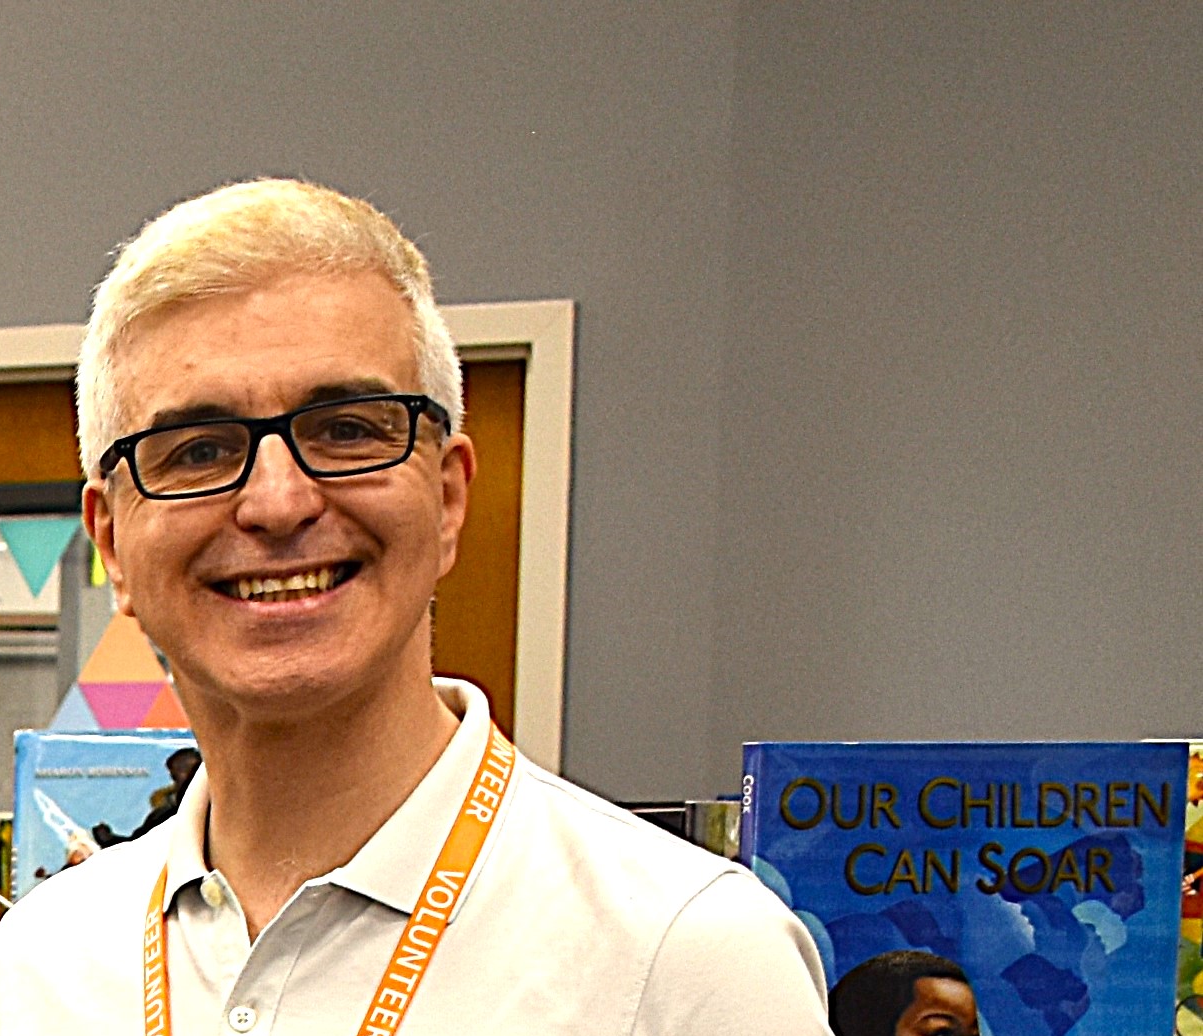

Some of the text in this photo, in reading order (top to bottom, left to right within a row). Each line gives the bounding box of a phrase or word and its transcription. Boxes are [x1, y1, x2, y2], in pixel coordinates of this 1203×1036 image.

[741, 774, 755, 814] COOK
[779, 775, 1170, 830] OUR CHILDREN
[844, 841, 1115, 896] CAN SOAR
